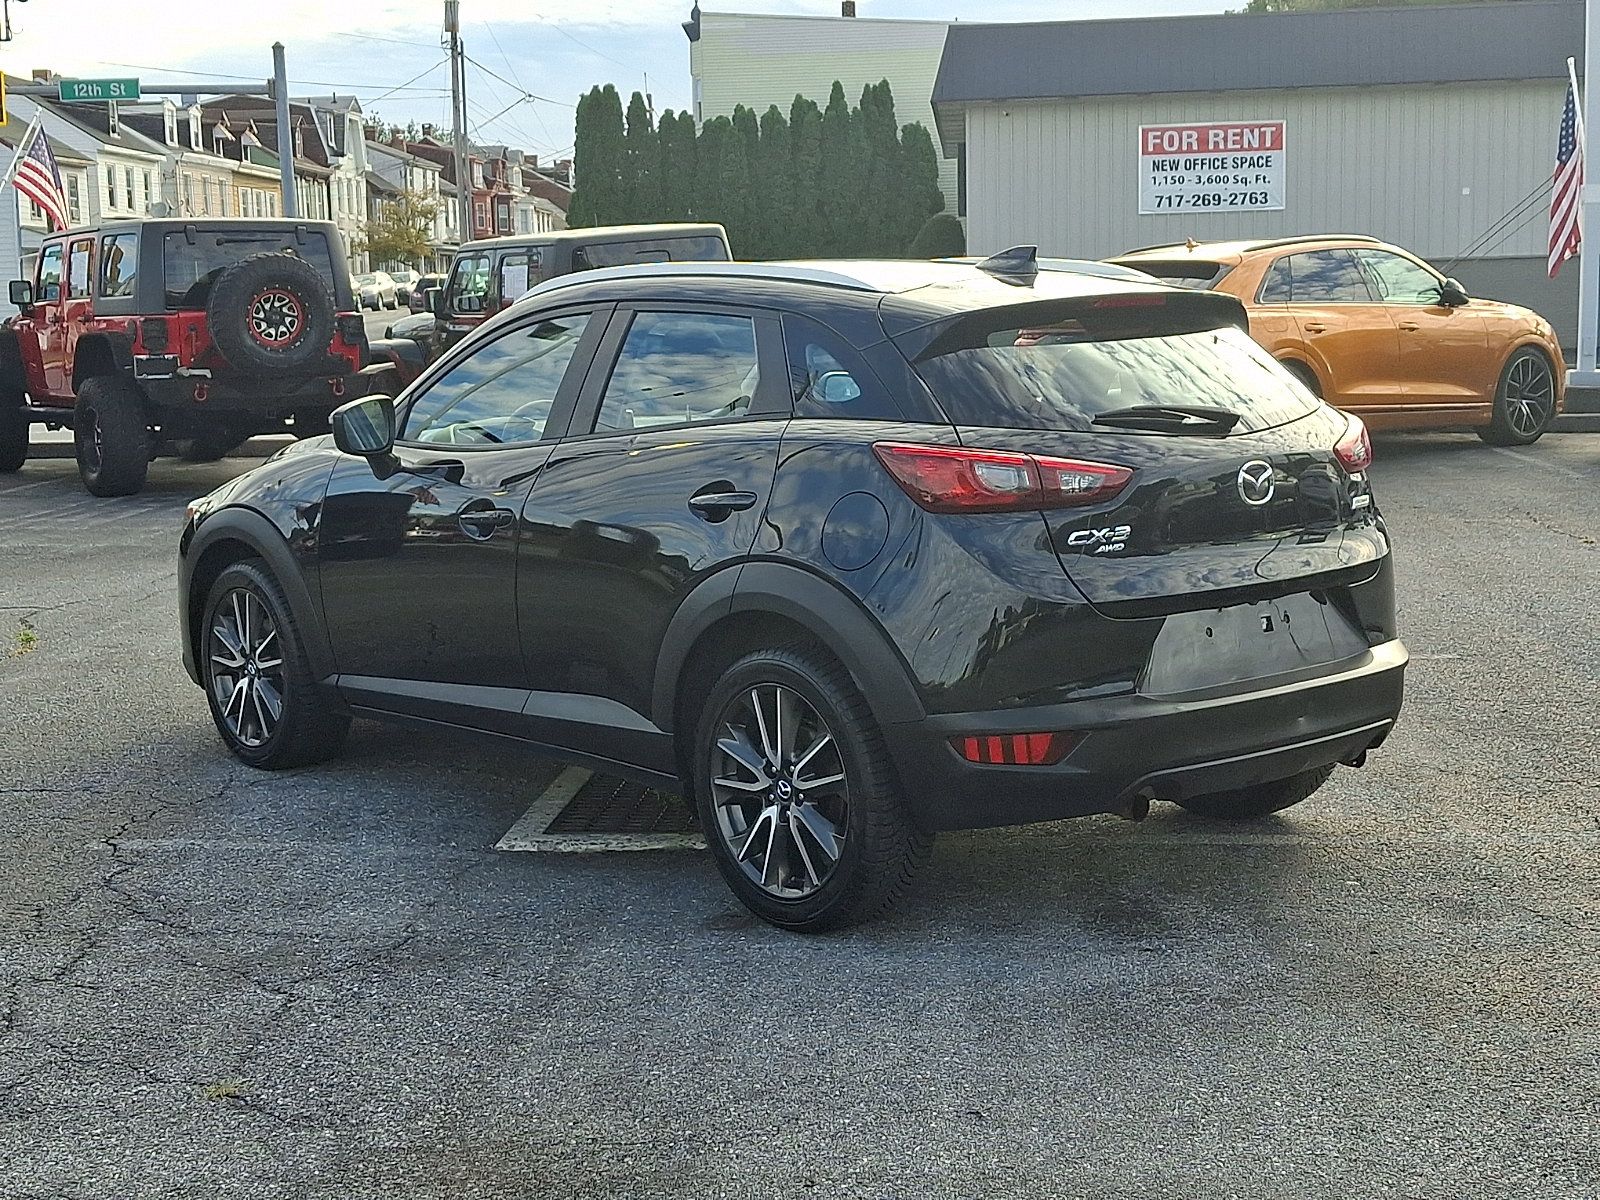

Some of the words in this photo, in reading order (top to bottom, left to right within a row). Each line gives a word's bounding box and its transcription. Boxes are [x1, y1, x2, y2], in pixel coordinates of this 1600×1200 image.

[73, 83, 102, 97] 12th
[109, 82, 126, 96] St
[1147, 130, 1198, 152] FOR
[1208, 126, 1277, 150] RENT
[1152, 158, 1181, 172] NEW
[1184, 156, 1228, 171] OFFICE
[1232, 155, 1272, 169] SPACE
[1151, 175, 1185, 187] 1,150
[1195, 174, 1230, 186] 3,600
[1232, 174, 1252, 187] Sq.
[1255, 173, 1271, 185] Ft.
[1154, 191, 1269, 208] 717-269-2763
[1067, 525, 1132, 546] CX-3
[1093, 542, 1125, 554] AWD
